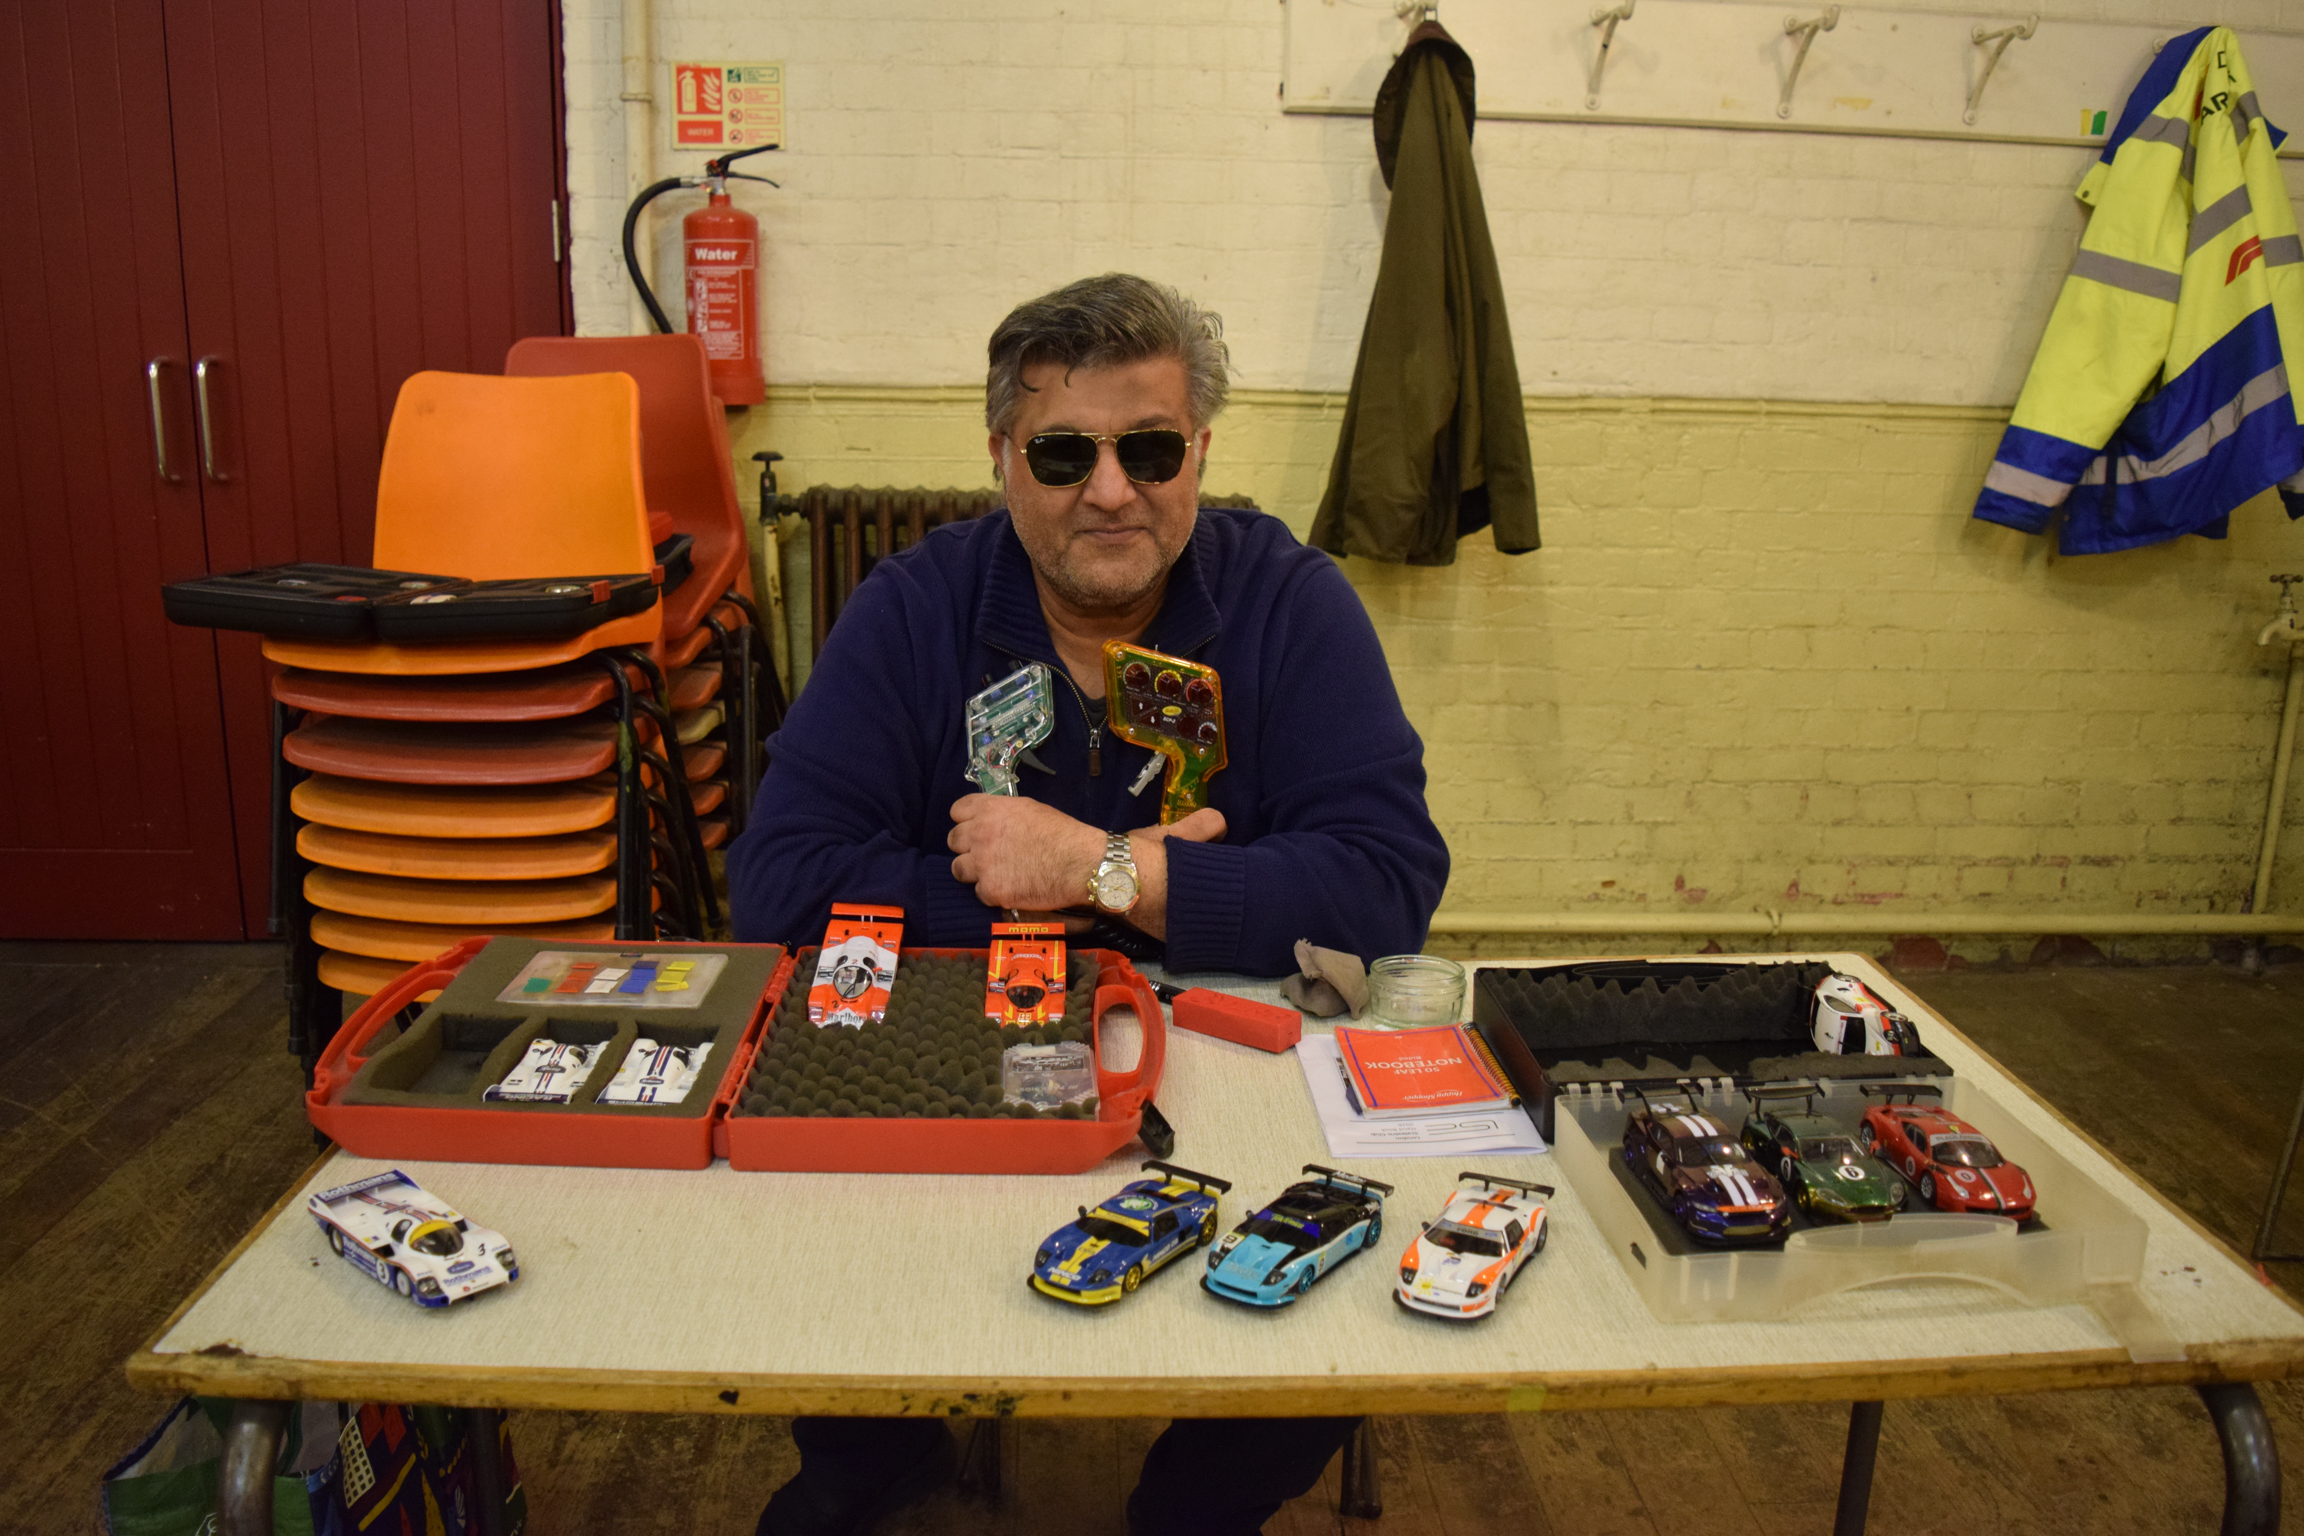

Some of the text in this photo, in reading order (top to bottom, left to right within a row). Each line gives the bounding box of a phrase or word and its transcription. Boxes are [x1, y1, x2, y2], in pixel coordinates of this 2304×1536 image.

[687, 127, 714, 136] WATER
[695, 248, 738, 261] Water
[832, 1000, 840, 1009] 2
[1364, 1057, 1463, 1069] NOTEBOOK
[1847, 1167, 1859, 1178] 6
[1963, 1172, 1972, 1181] 0
[319, 1171, 401, 1200] Rothmans
[478, 1243, 486, 1257] 3
